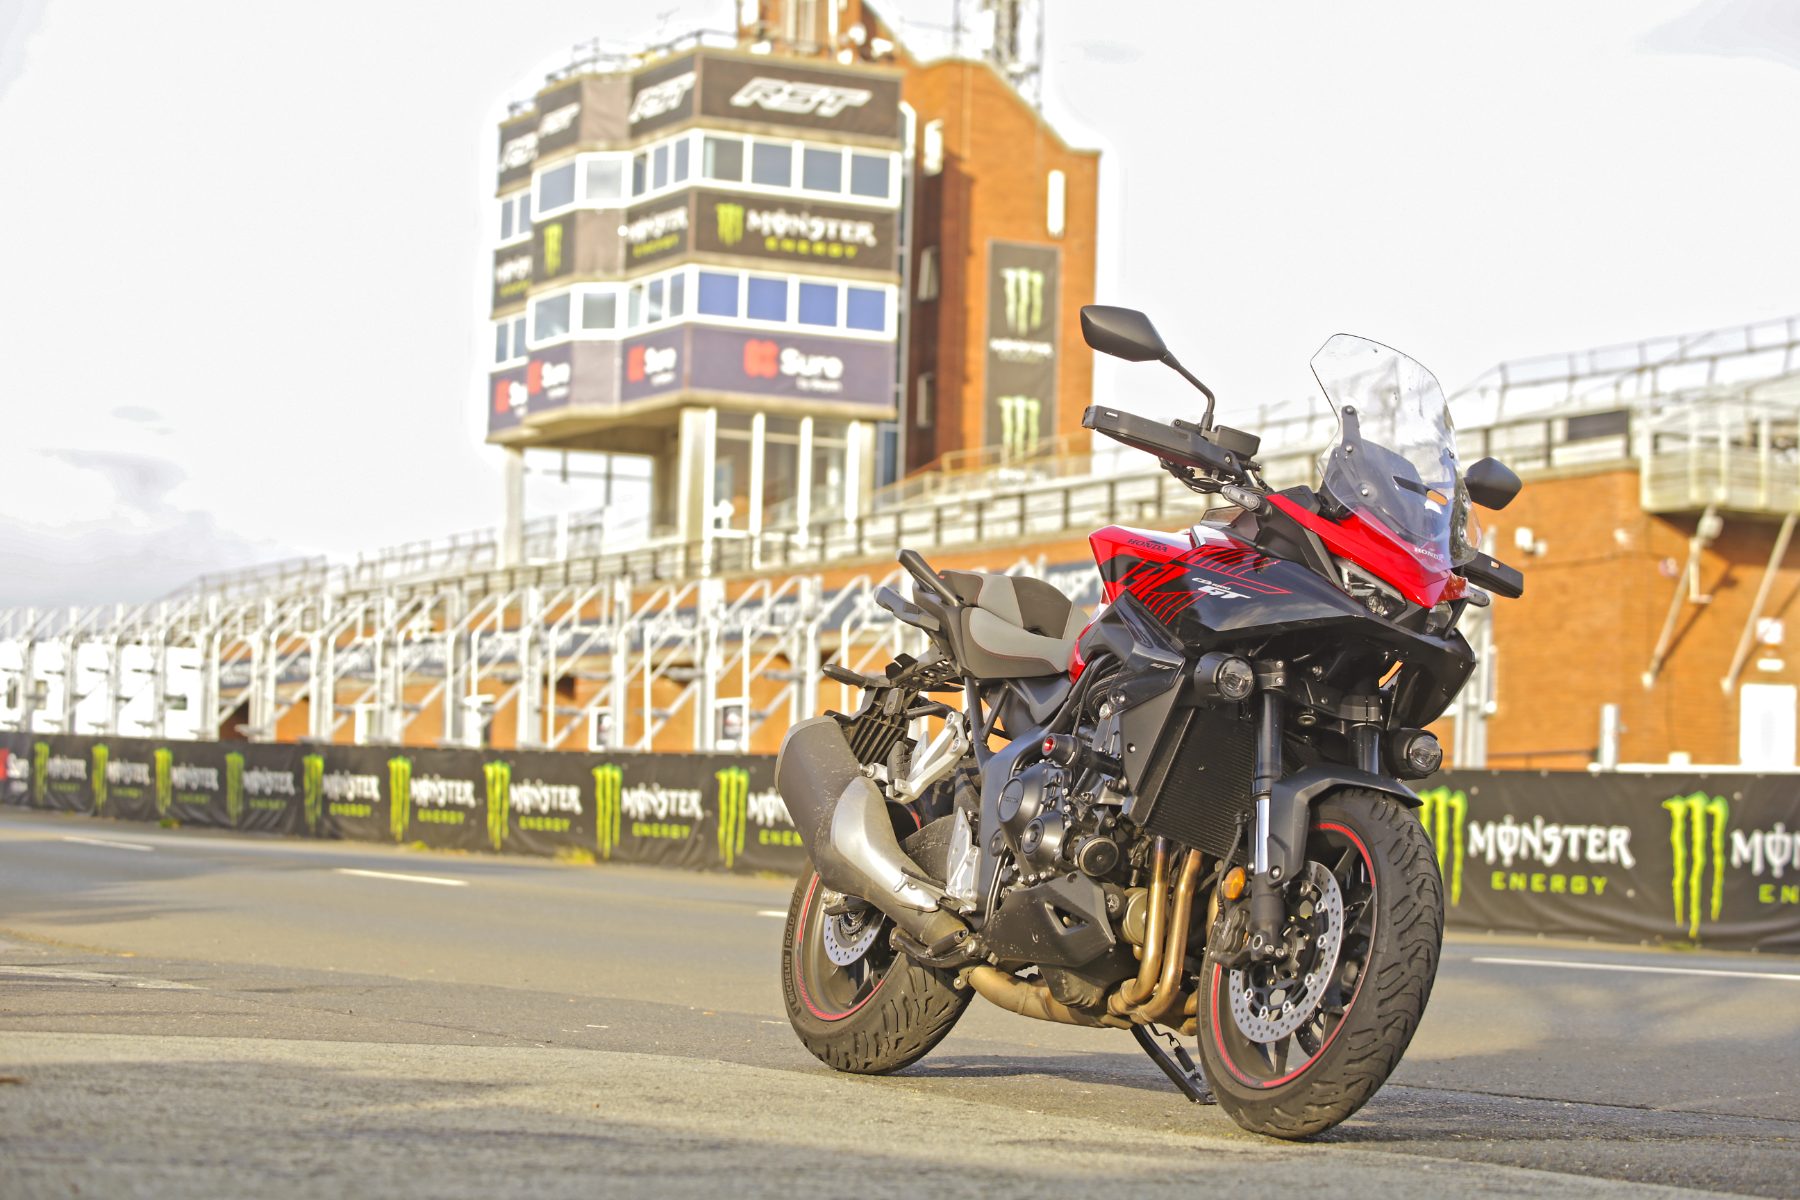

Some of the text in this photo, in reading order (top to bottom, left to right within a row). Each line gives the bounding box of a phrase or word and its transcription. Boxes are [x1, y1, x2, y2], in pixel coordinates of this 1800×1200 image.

[1127, 537, 1169, 553] HONDA
[1414, 546, 1444, 563] HONDA
[509, 778, 583, 815] MONSTER
[620, 782, 704, 820] MONSTER
[1468, 814, 1636, 869] MONSTER
[1491, 870, 1608, 896] ENERGY
[785, 917, 796, 947] ROAD
[783, 953, 798, 1004] MICHELIN
